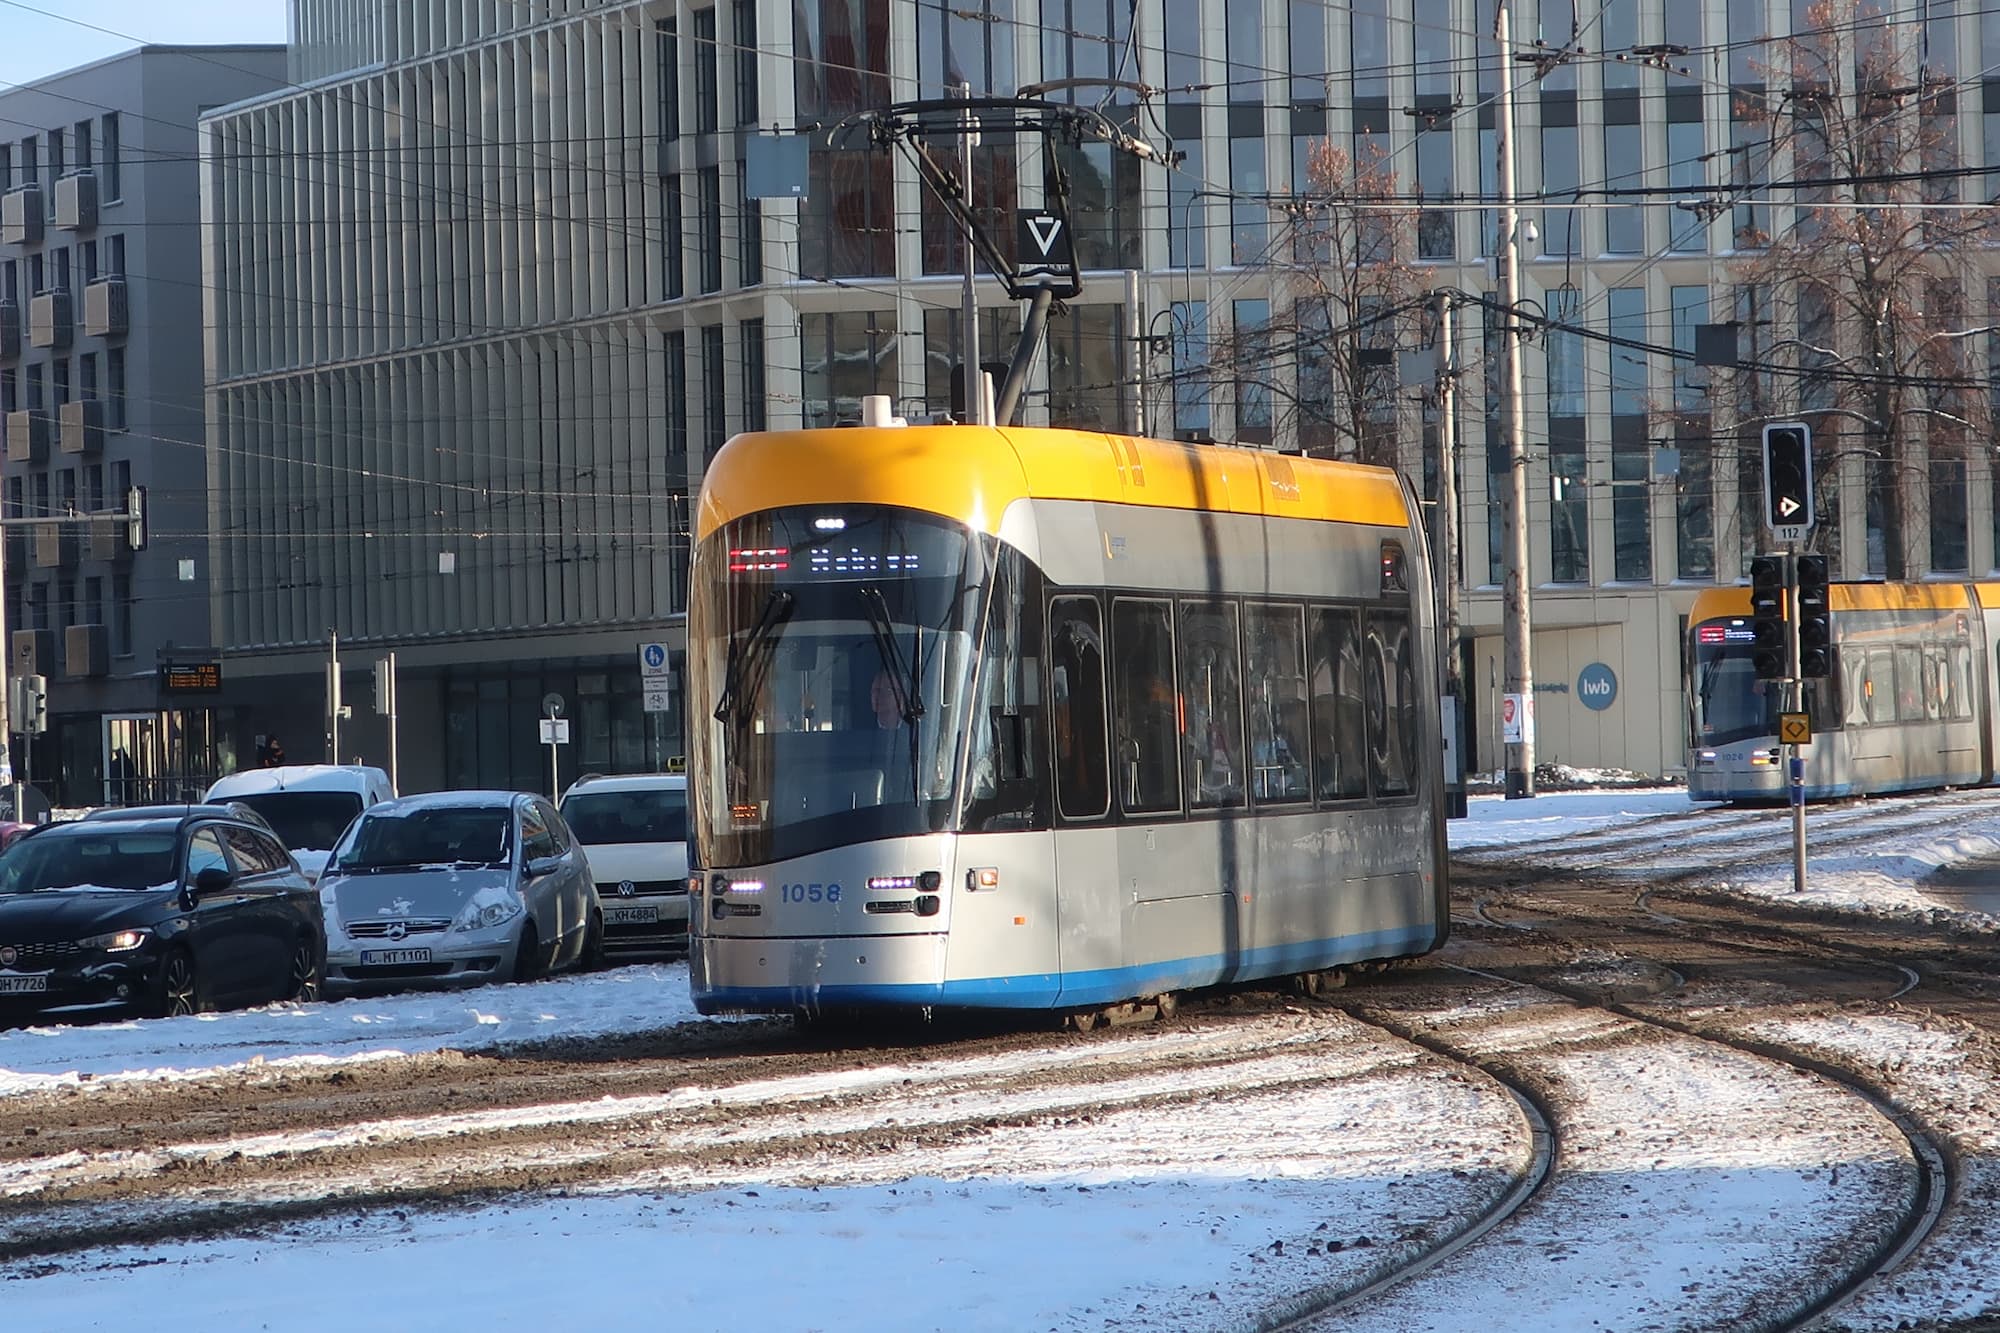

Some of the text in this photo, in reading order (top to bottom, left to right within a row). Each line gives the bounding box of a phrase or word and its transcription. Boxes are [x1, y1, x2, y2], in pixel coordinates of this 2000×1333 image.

[1782, 527, 1800, 539] 112
[1583, 678, 1611, 696] lwb
[782, 883, 841, 903] 1058
[400, 950, 429, 962] 1101
[14, 977, 46, 991] 7726
